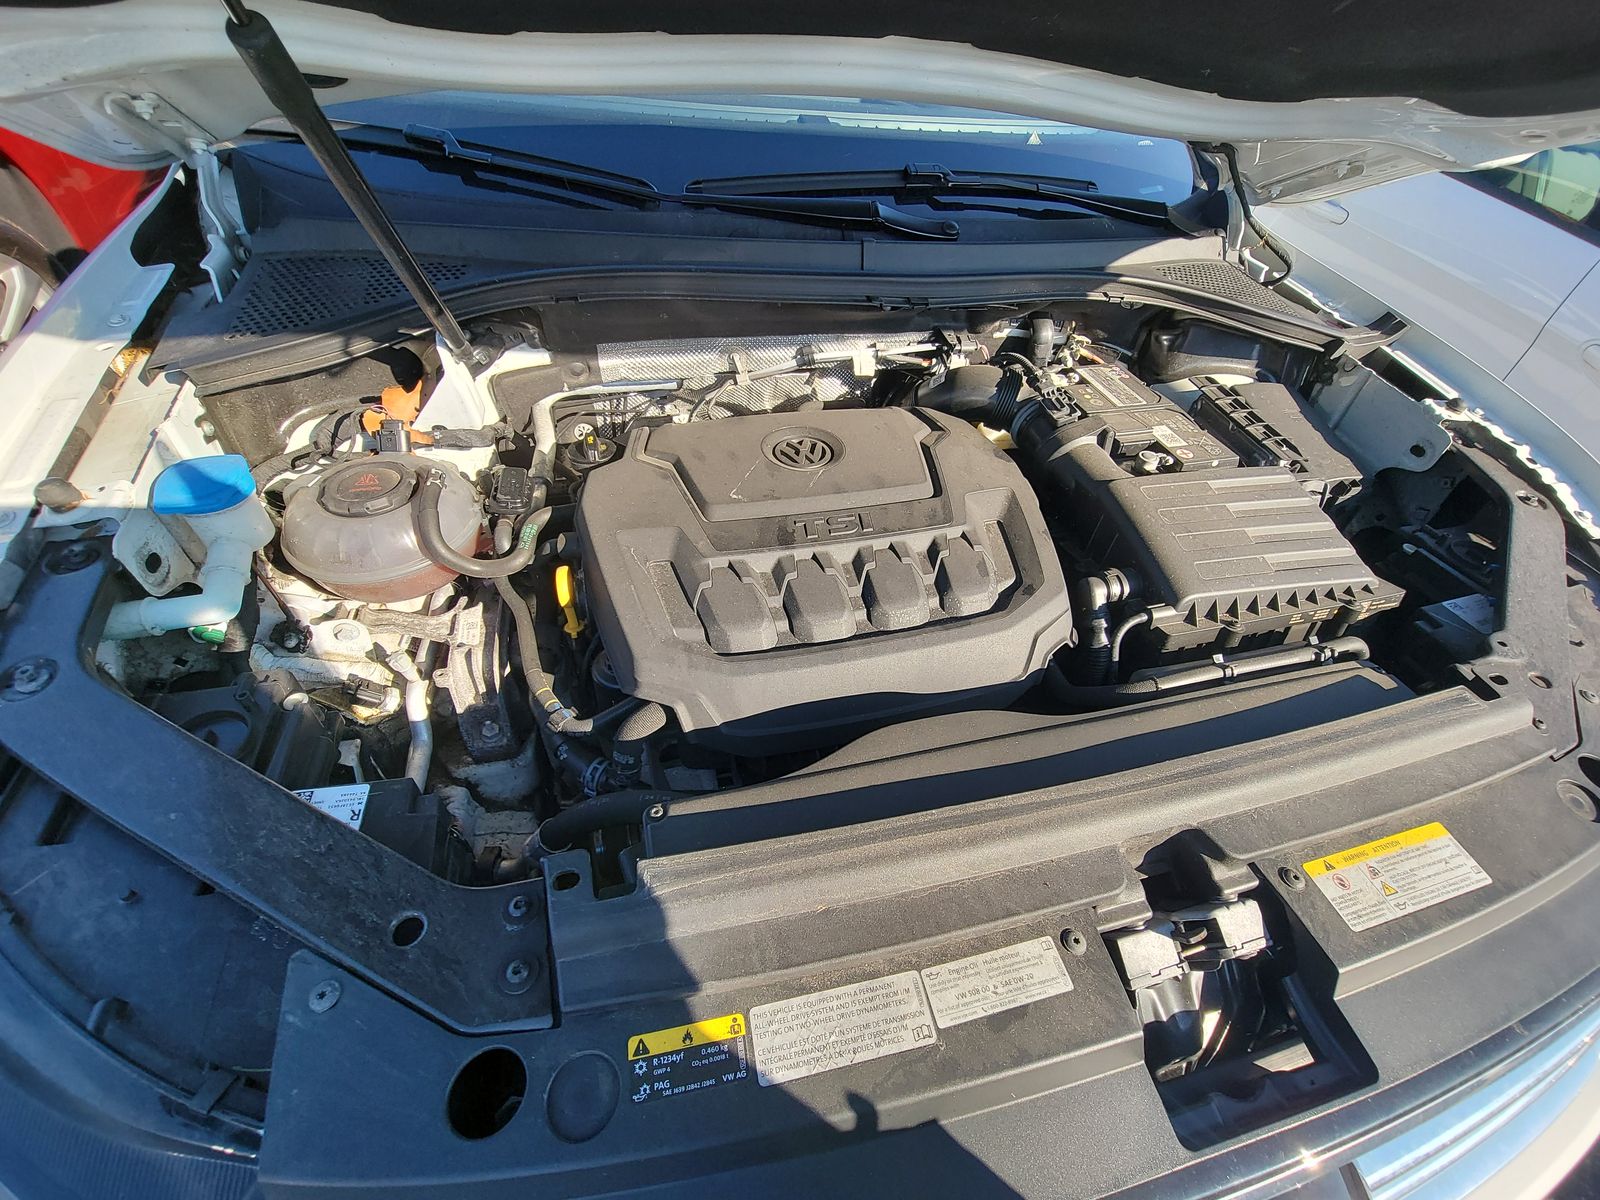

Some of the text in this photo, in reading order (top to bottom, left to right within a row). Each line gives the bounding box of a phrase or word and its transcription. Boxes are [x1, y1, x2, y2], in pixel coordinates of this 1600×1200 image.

[772, 437, 834, 470] VW
[794, 512, 874, 539] TSI
[350, 808, 361, 821] R
[1341, 850, 1369, 863] WARNING
[1370, 839, 1401, 852] ATTENTION
[947, 961, 978, 977] Engine Oil
[981, 950, 1020, 966] Huile moteur
[954, 990, 968, 1001] VW
[967, 986, 981, 997] 508
[980, 984, 991, 993] 00
[999, 978, 1013, 987] SAE
[1012, 972, 1034, 984] 0W-20
[753, 980, 895, 1021] THIS VEHICLE IS EQUIPPED WITH A PERMANENT
[754, 1015, 790, 1030] ALL-WHEEL
[791, 1010, 810, 1021] DRIVE
[810, 1005, 834, 1016] SYSTEM
[834, 1001, 850, 1011] AND
[850, 999, 856, 1007] IS
[857, 994, 881, 1005] EXEMPT
[881, 989, 899, 999] FROM
[755, 1027, 782, 1040] TESTING
[783, 1024, 794, 1033] ON
[795, 1014, 836, 1031] TWO-WHEEL
[835, 1009, 855, 1021] DRIVE
[757, 1047, 766, 1056] CE
[798, 1036, 810, 1046] EST
[872, 1019, 881, 1028] DE
[880, 1008, 925, 1026] TRANSMISSION
[652, 1042, 728, 1069] R-1234yf 0.460 kg
[760, 1067, 773, 1077] SUR
[873, 1035, 904, 1049] MOTRICES
[793, 1042, 830, 1058] PERMANENT
[653, 1067, 665, 1076] GWP
[722, 1069, 747, 1082] VW AG
[653, 1079, 670, 1090] PAG
[662, 1088, 672, 1097] SAE
